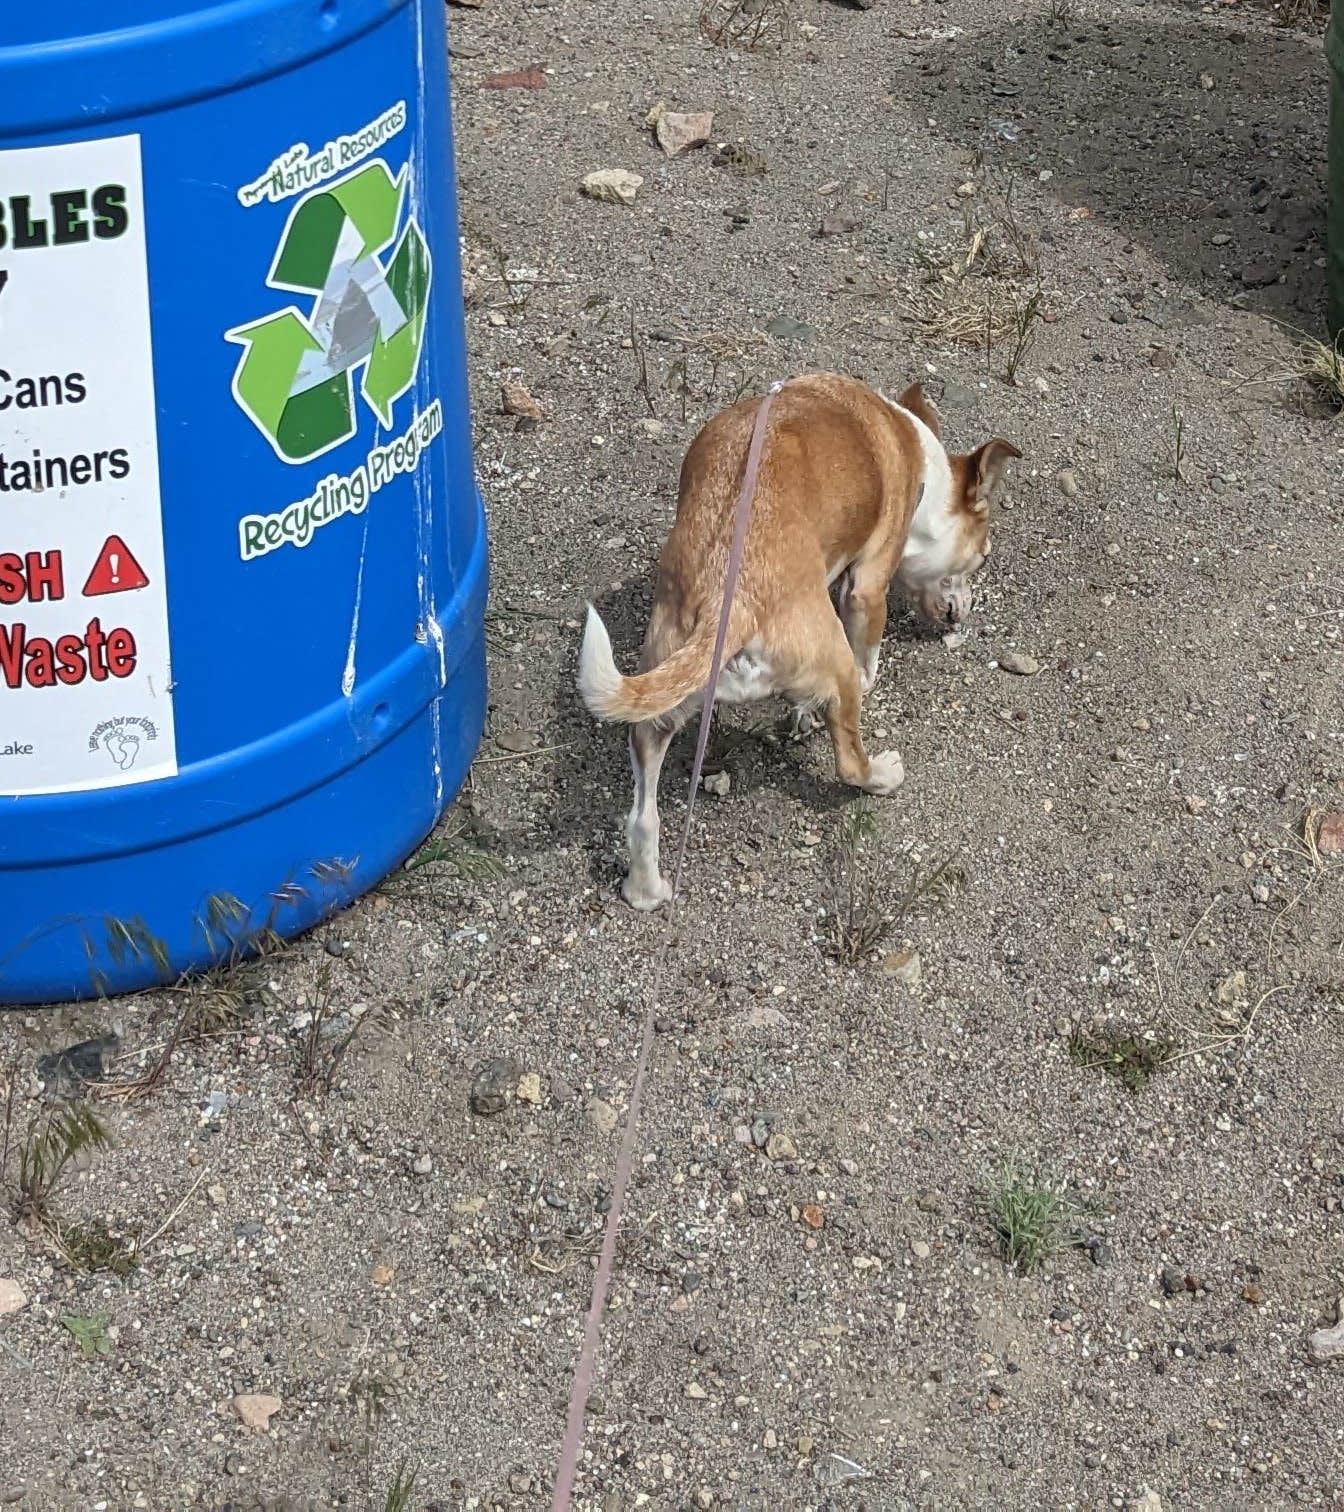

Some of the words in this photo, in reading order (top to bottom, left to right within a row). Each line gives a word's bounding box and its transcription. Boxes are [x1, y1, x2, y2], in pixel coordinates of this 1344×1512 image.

[272, 148, 335, 196] Natural
[340, 107, 403, 165] Resources
[244, 472, 365, 556] Recycling
